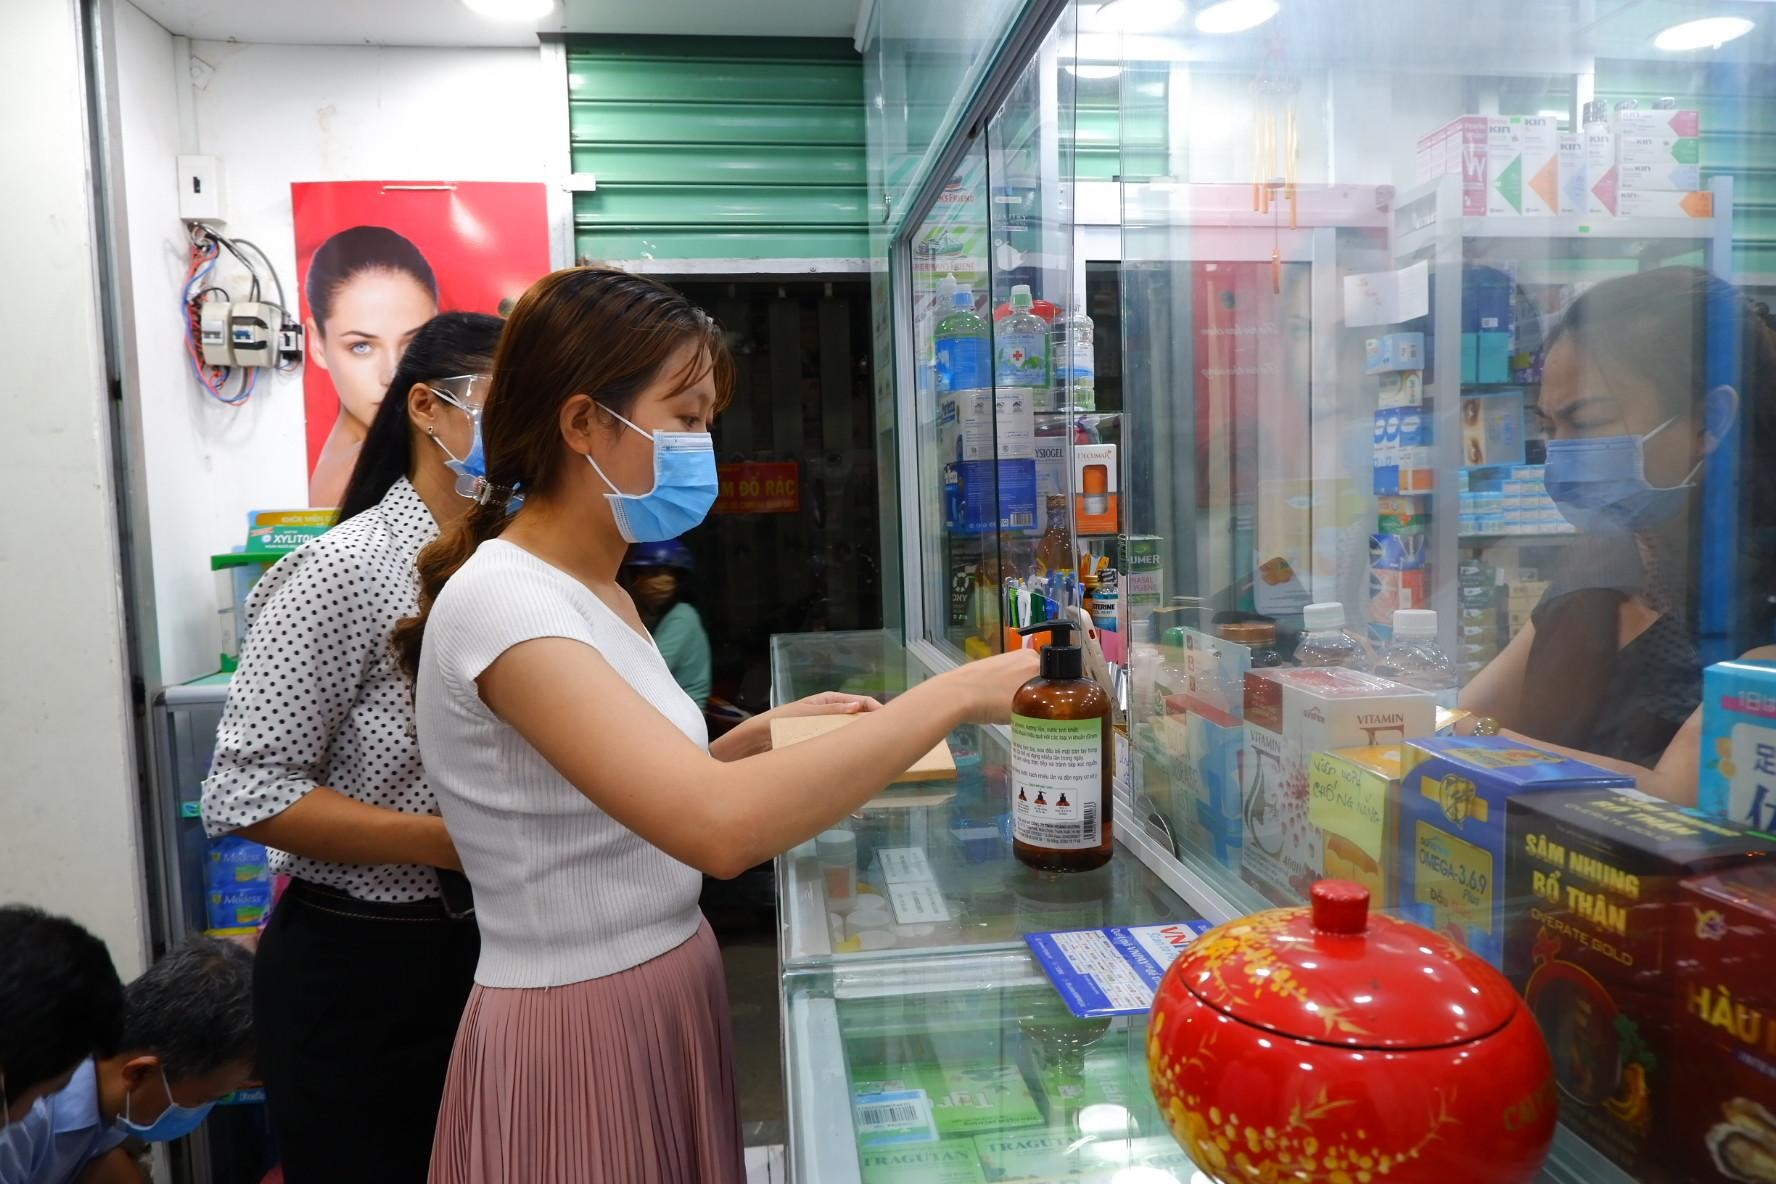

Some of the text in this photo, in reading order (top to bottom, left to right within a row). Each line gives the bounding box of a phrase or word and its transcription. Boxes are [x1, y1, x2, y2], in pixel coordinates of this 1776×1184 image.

[1034, 447, 1065, 458] YSIOGEL
[721, 481, 734, 497] M
[1130, 554, 1161, 564] UMER
[1357, 714, 1404, 725] VITAMIN
[1250, 728, 1281, 753] VITAMIN
[1525, 832, 1566, 869] SÂM
[1419, 849, 1488, 895] OMEGA-3.6.9
[1591, 937, 1634, 967] GOLD
